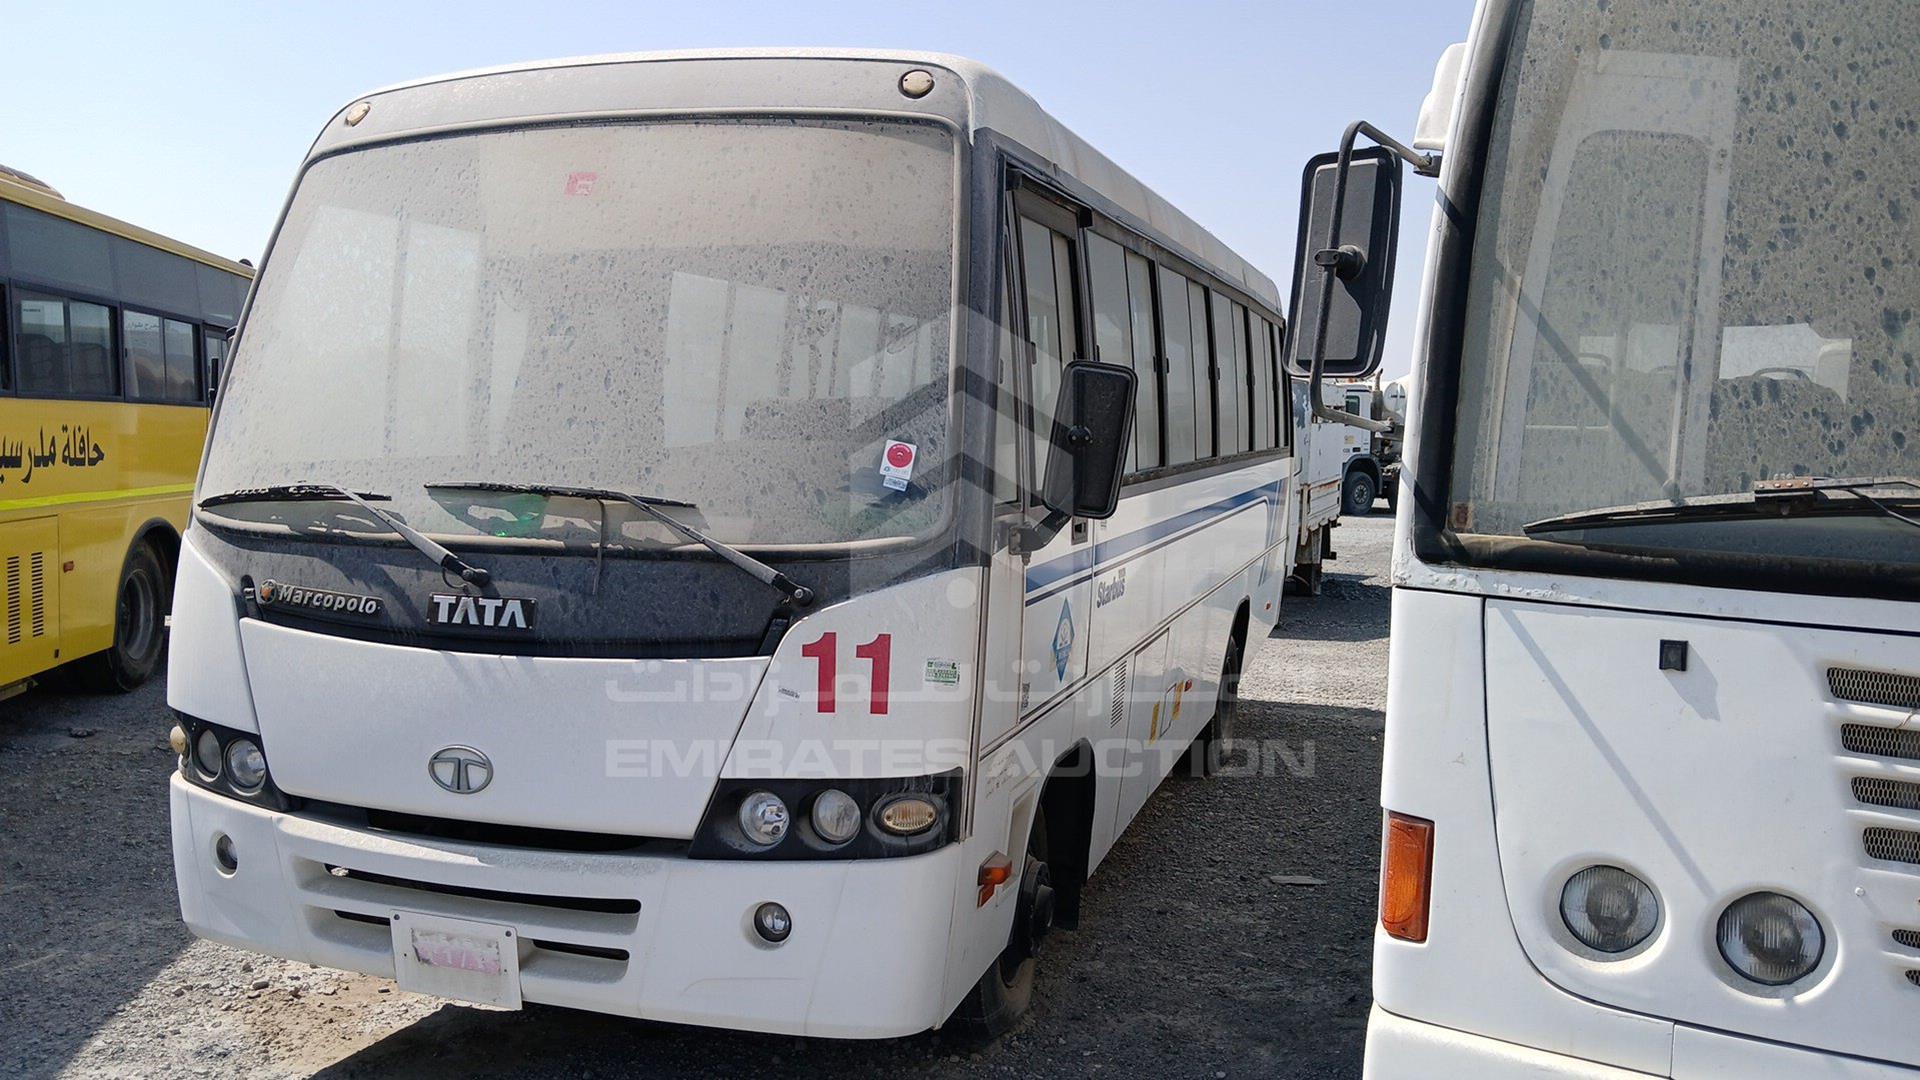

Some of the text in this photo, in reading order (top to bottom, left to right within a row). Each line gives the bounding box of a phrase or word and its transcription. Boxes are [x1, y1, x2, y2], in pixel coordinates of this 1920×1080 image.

[0, 424, 104, 484] حافلة مدرسي
[278, 584, 377, 615] Marcopolo
[433, 594, 527, 629] TATA
[802, 632, 891, 714] 11
